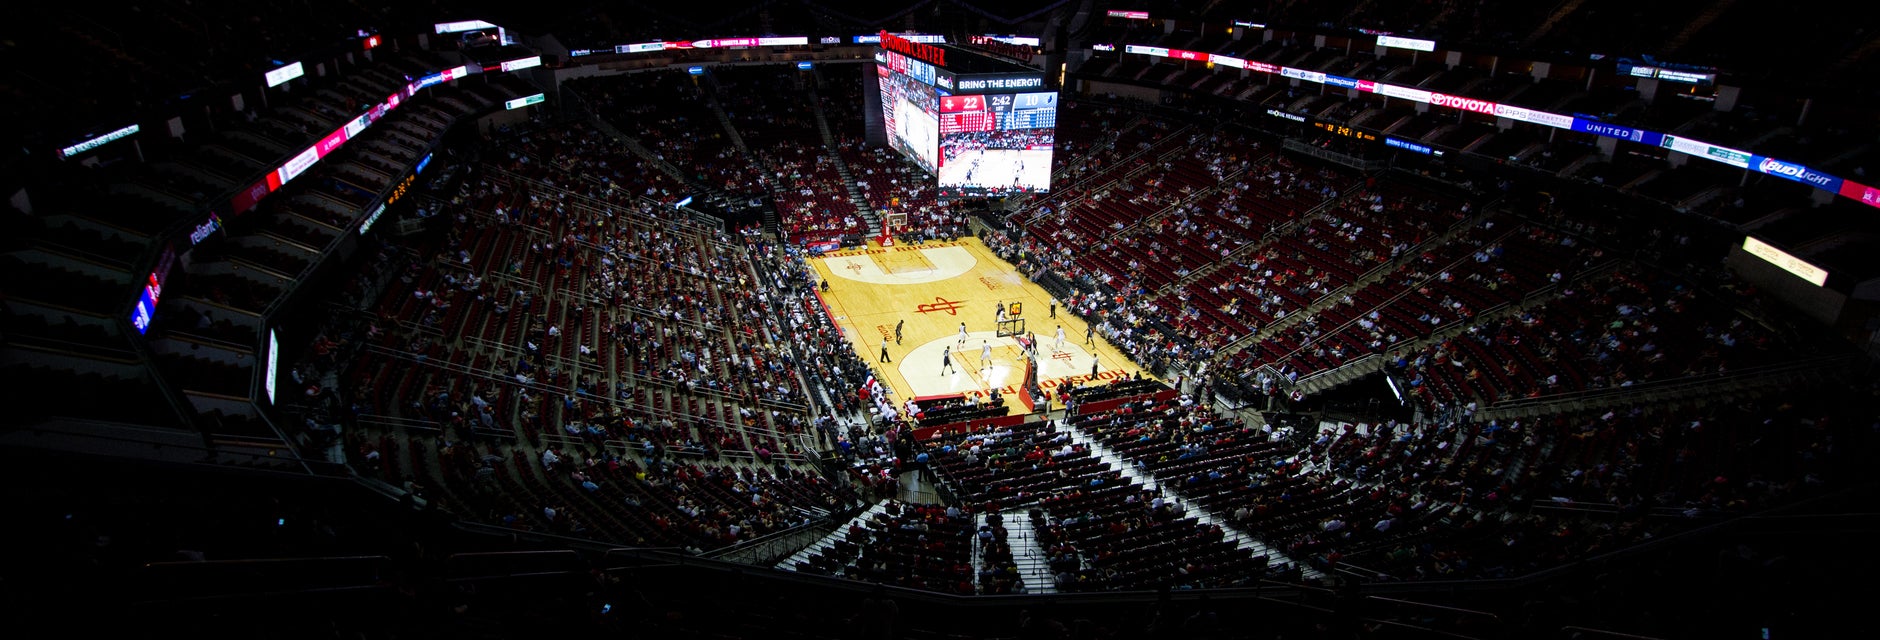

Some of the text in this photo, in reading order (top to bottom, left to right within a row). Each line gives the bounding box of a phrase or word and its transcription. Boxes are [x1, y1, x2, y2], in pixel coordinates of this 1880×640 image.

[887, 34, 911, 55] TOYOTA
[911, 41, 945, 67] CENTER
[1093, 44, 1109, 52] reliant
[959, 78, 1041, 90] BRING THE ENERGY!
[963, 97, 978, 109] 22
[992, 95, 1011, 106] 2:42
[1025, 95, 1039, 106] 10
[1445, 96, 1494, 115] TOYOTA
[1505, 109, 1527, 119] PPS
[1586, 123, 1629, 137] UNITED
[1766, 161, 1832, 185] BUD LIGHT
[190, 218, 216, 245] reliant
[1040, 369, 1127, 390] HOUSTO
